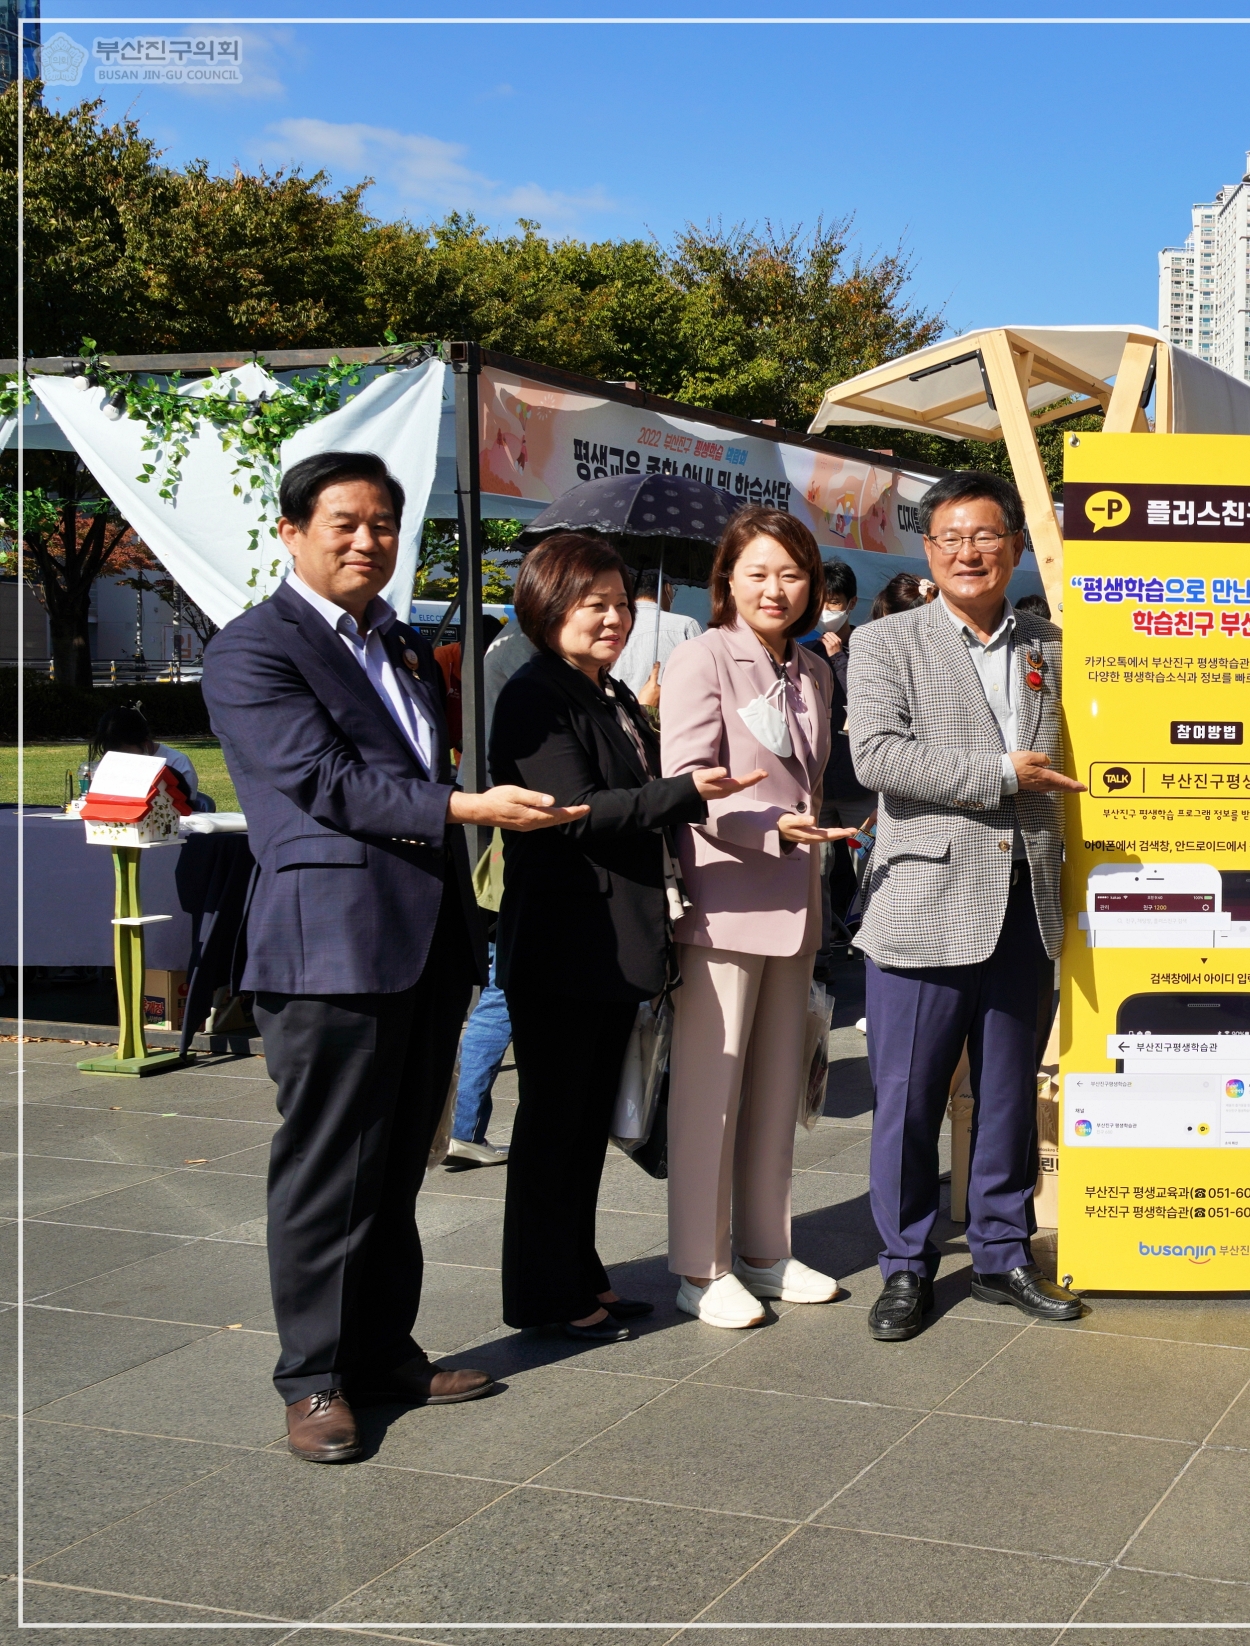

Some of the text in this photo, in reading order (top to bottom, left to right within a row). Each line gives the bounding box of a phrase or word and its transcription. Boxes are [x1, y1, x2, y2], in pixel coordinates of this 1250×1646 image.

[637, 426, 749, 466] 2022 부산진구 평생학습 박람회
[1071, 577, 1206, 604] “평생학습으로
[419, 614, 435, 622] ELEC
[1132, 610, 1215, 637] 학습친구
[1084, 656, 1149, 669] 카카오톡에서
[1152, 657, 1194, 669] 부산진구
[1197, 657, 1250, 670] 평생학습관
[1088, 671, 1120, 683] 다양한
[1123, 671, 1198, 684] 평생학습소식과
[1200, 672, 1232, 684] 정보를
[1177, 724, 1237, 740] 참여방법
[1105, 774, 1129, 784] TALK
[1102, 809, 1137, 820] 부산진구
[1139, 809, 1174, 821] 평생학습
[1177, 809, 1211, 821] 프로그램
[1213, 809, 1239, 822] 정보를
[1084, 840, 1137, 852] 아이폰에서
[1139, 840, 1172, 853] 검색창,
[1175, 840, 1247, 852] 안드로이드에서
[1150, 973, 1201, 985] 검색창에서
[1203, 973, 1235, 985] 아이디
[1136, 1042, 1218, 1053] 부산진구평생학습관
[1084, 1186, 1130, 1199] 부산진구
[1084, 1206, 1130, 1219] 부산진구
[1139, 1241, 1216, 1260] busanjin
